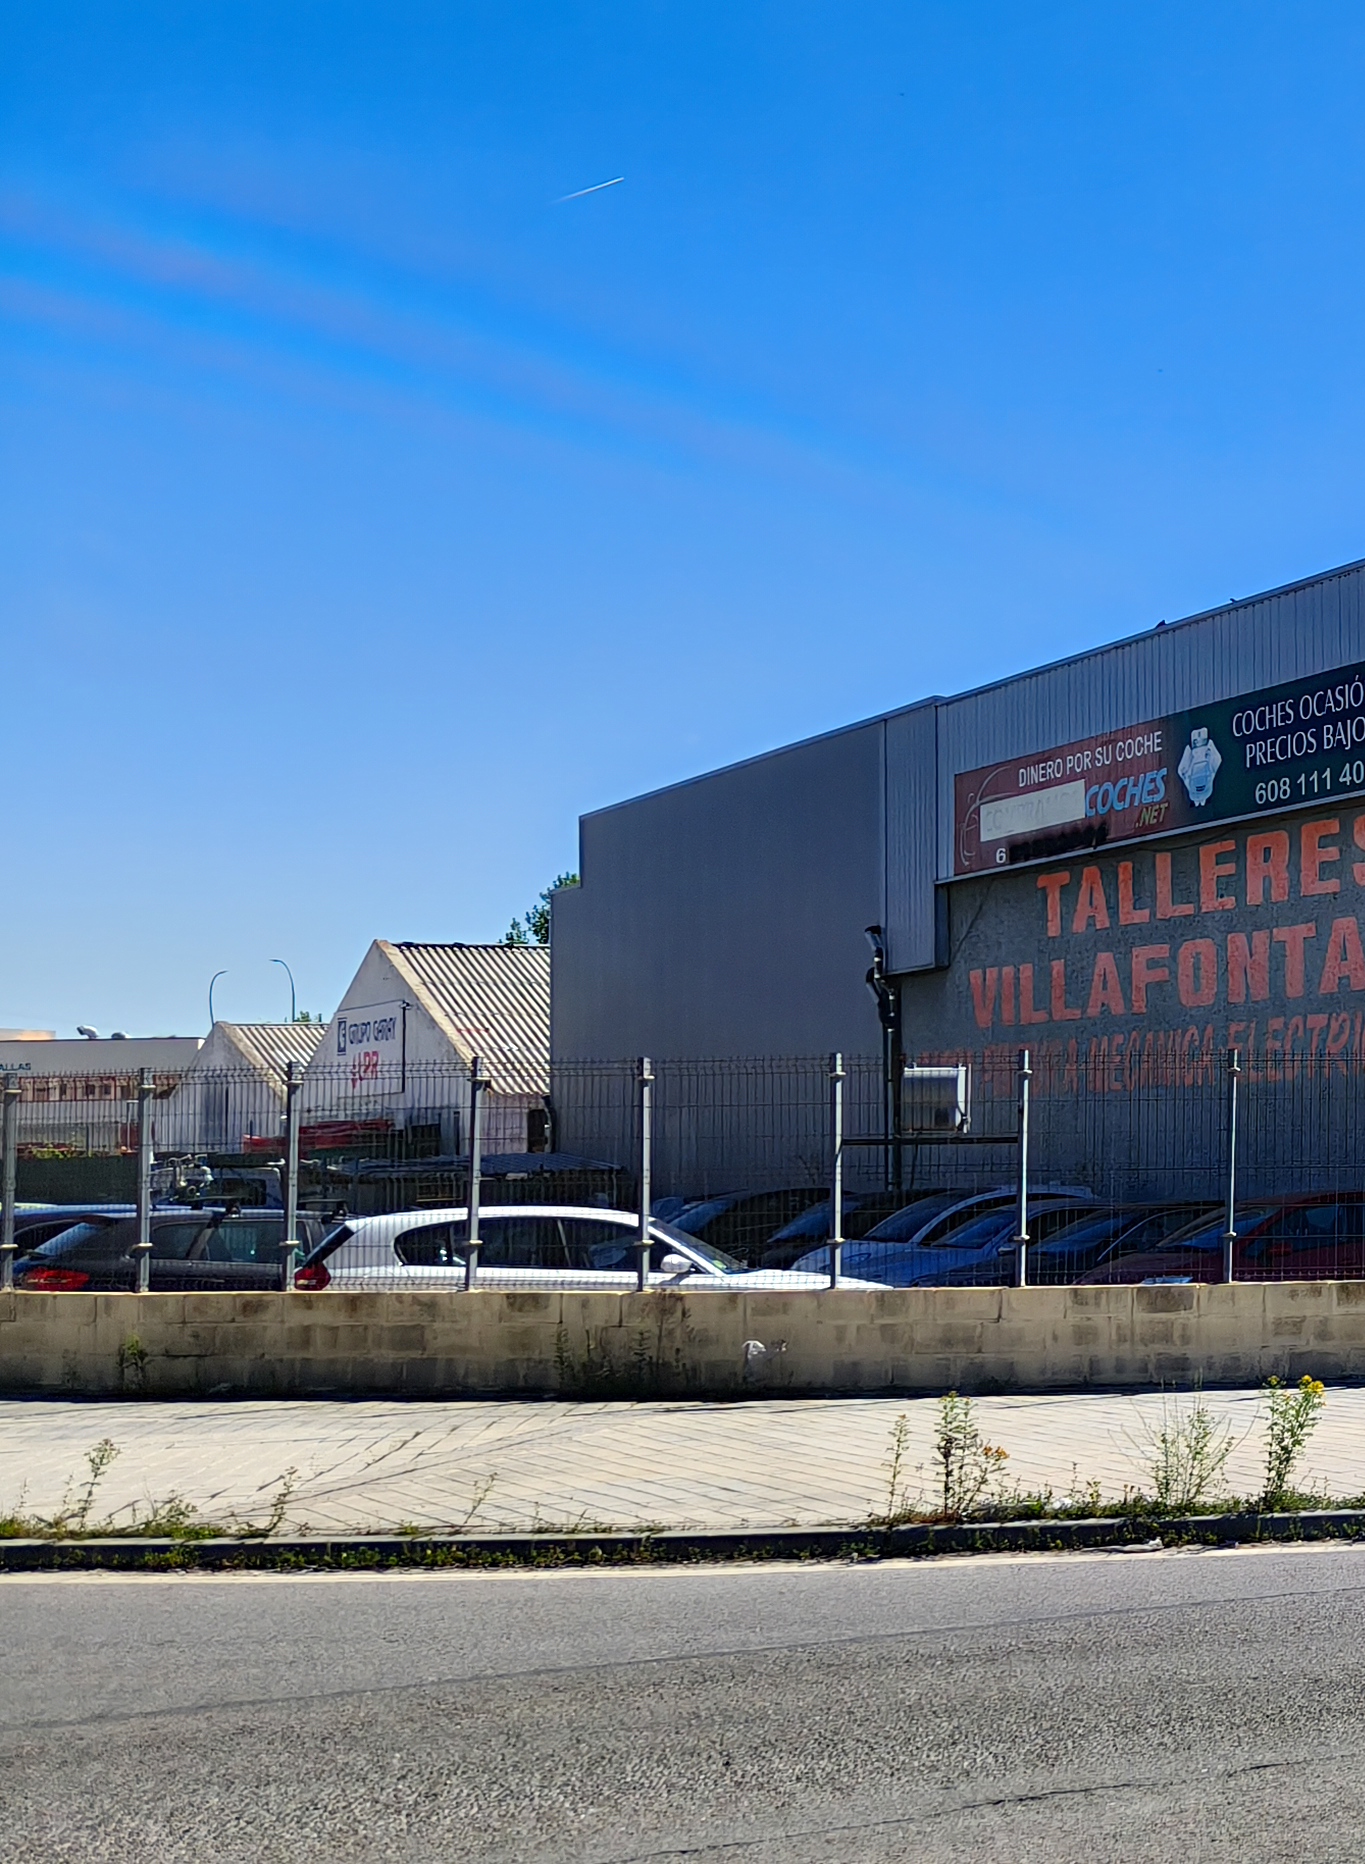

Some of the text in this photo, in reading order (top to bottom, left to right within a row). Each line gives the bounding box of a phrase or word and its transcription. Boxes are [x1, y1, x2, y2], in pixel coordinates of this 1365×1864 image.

[1233, 699, 1294, 737] COCHES
[1018, 731, 1163, 788] DINERO POR SU COCHE
[1246, 728, 1316, 768] PRECIOS
[1085, 768, 1167, 817] COCHES
[1255, 778, 1290, 804] 608
[1297, 768, 1331, 795] 111
[1135, 803, 1168, 827] .NET
